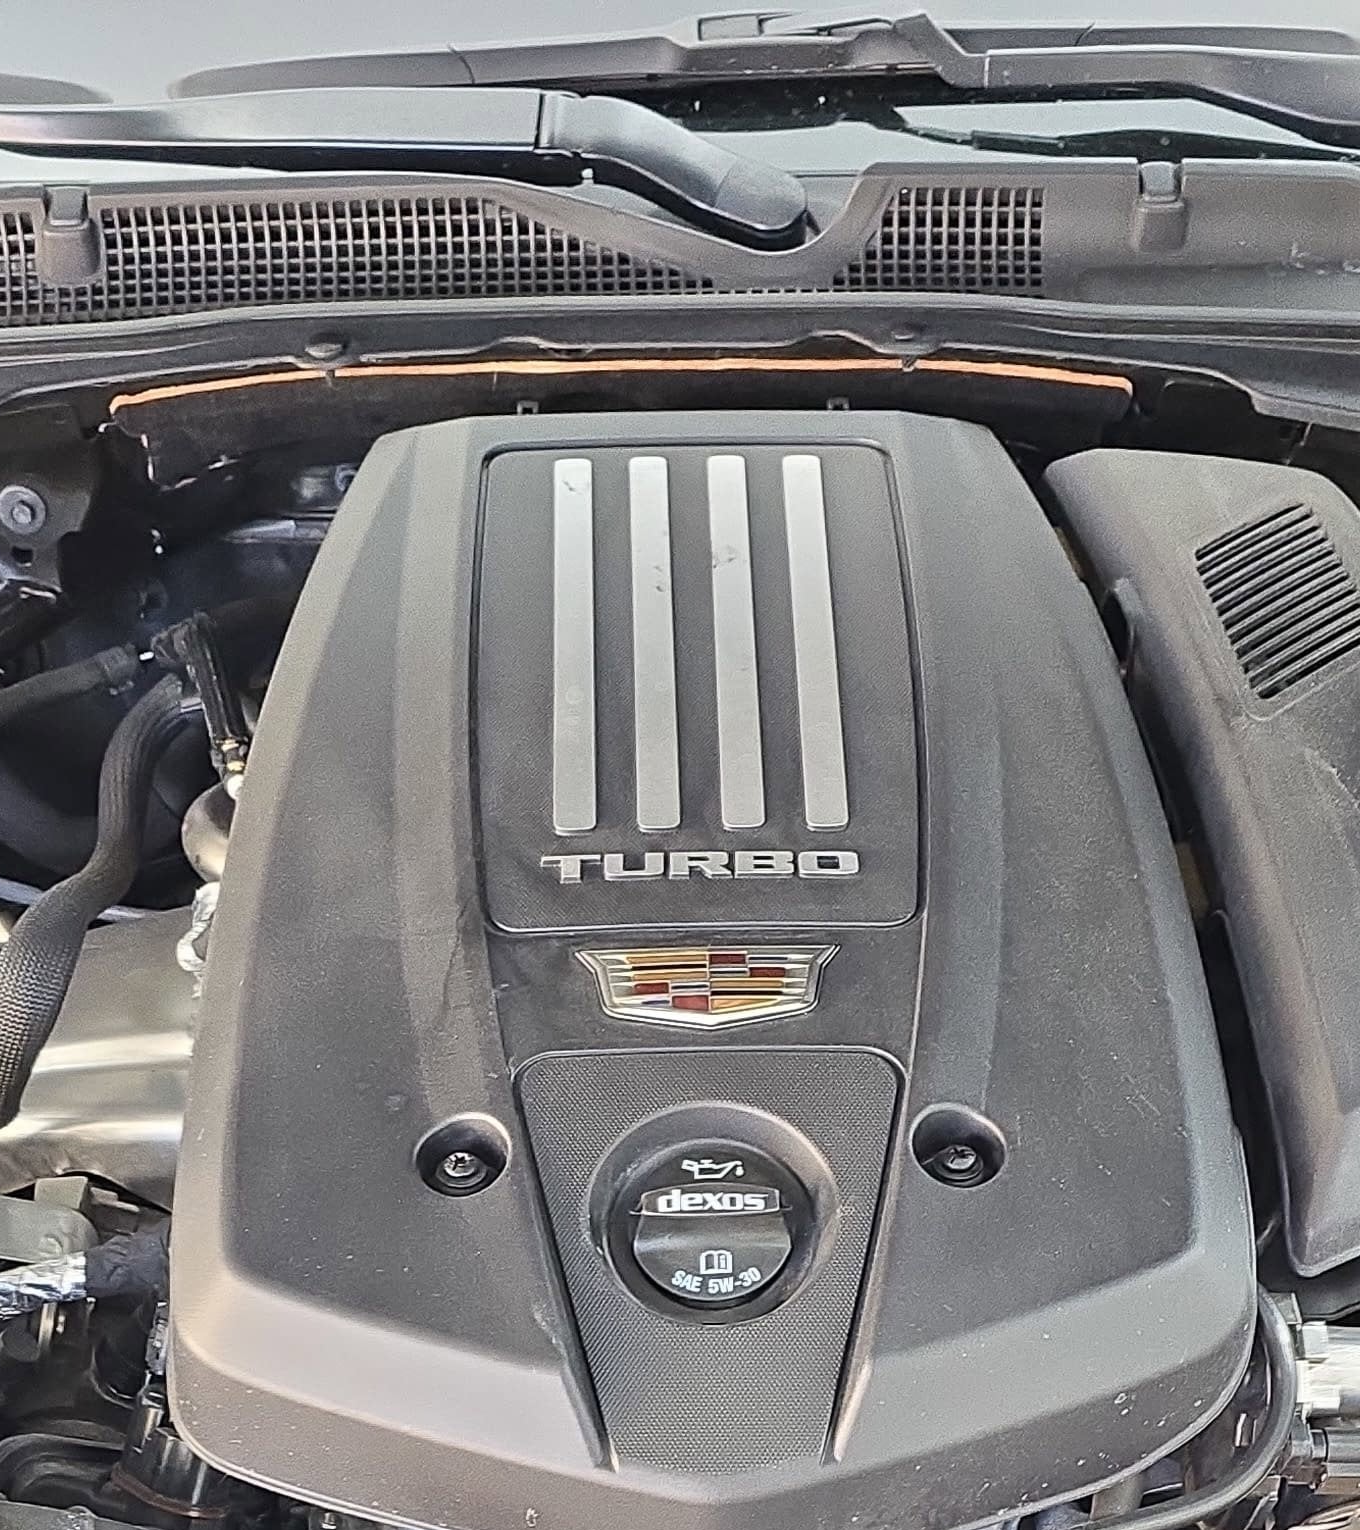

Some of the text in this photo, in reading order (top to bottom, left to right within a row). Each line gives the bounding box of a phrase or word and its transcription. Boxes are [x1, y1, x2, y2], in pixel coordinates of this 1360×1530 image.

[540, 850, 860, 884] TURBO
[657, 1189, 768, 1213] dexos
[671, 1266, 762, 1294] SAE 5W-30
